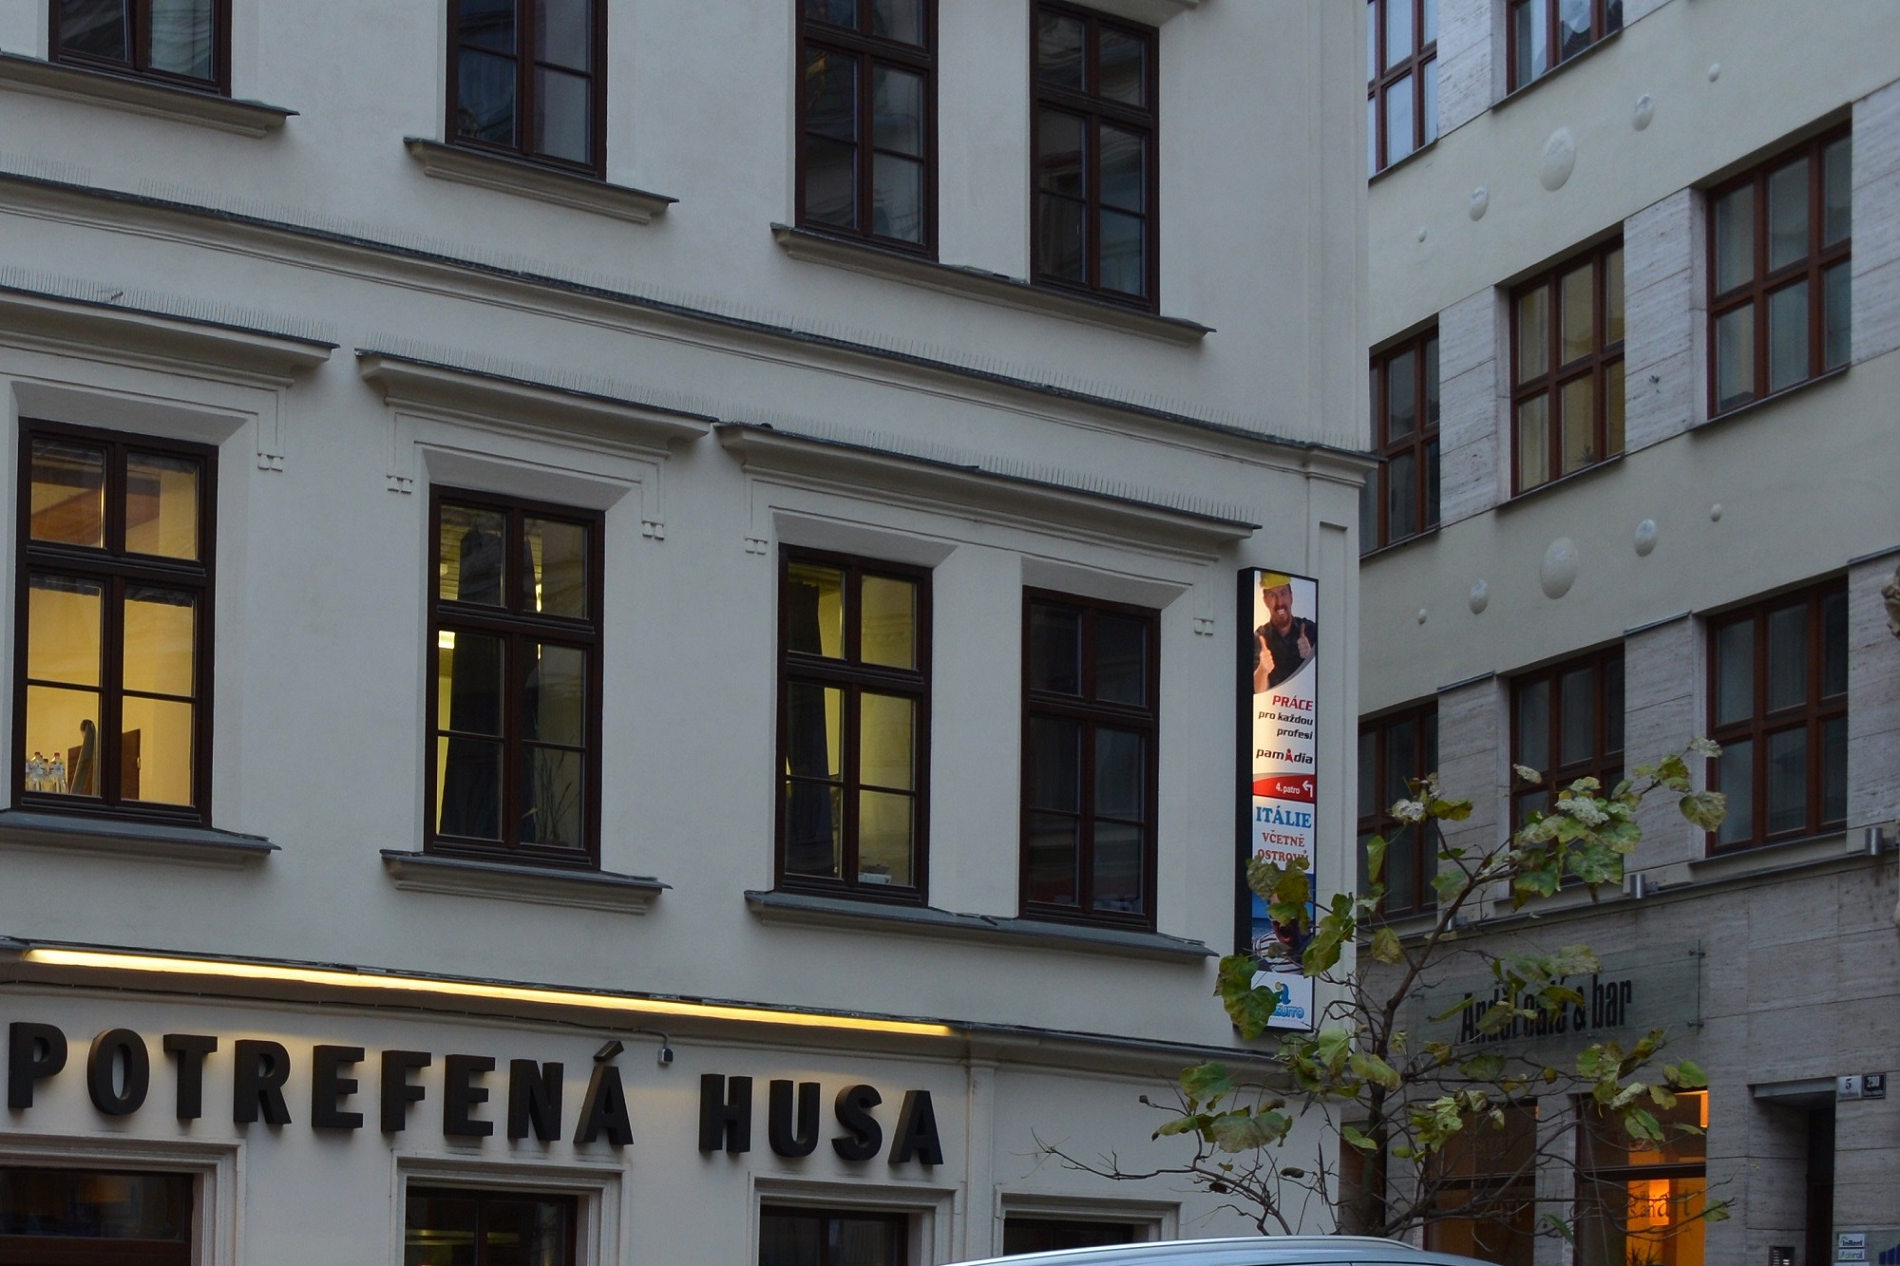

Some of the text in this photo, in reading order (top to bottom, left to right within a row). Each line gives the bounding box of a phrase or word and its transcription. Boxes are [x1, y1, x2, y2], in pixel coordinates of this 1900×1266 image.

[1272, 695, 1313, 712] PRÁCE
[1258, 711, 1313, 726] pro každou
[1276, 728, 1313, 740] profesi
[1256, 806, 1312, 829] ITÁLIE
[1262, 830, 1305, 847] VČETNĚ
[1592, 973, 1632, 1029] bar
[1845, 1078, 1852, 1090] 5
[8, 1021, 943, 1166] POTREFENÁ HUSA
